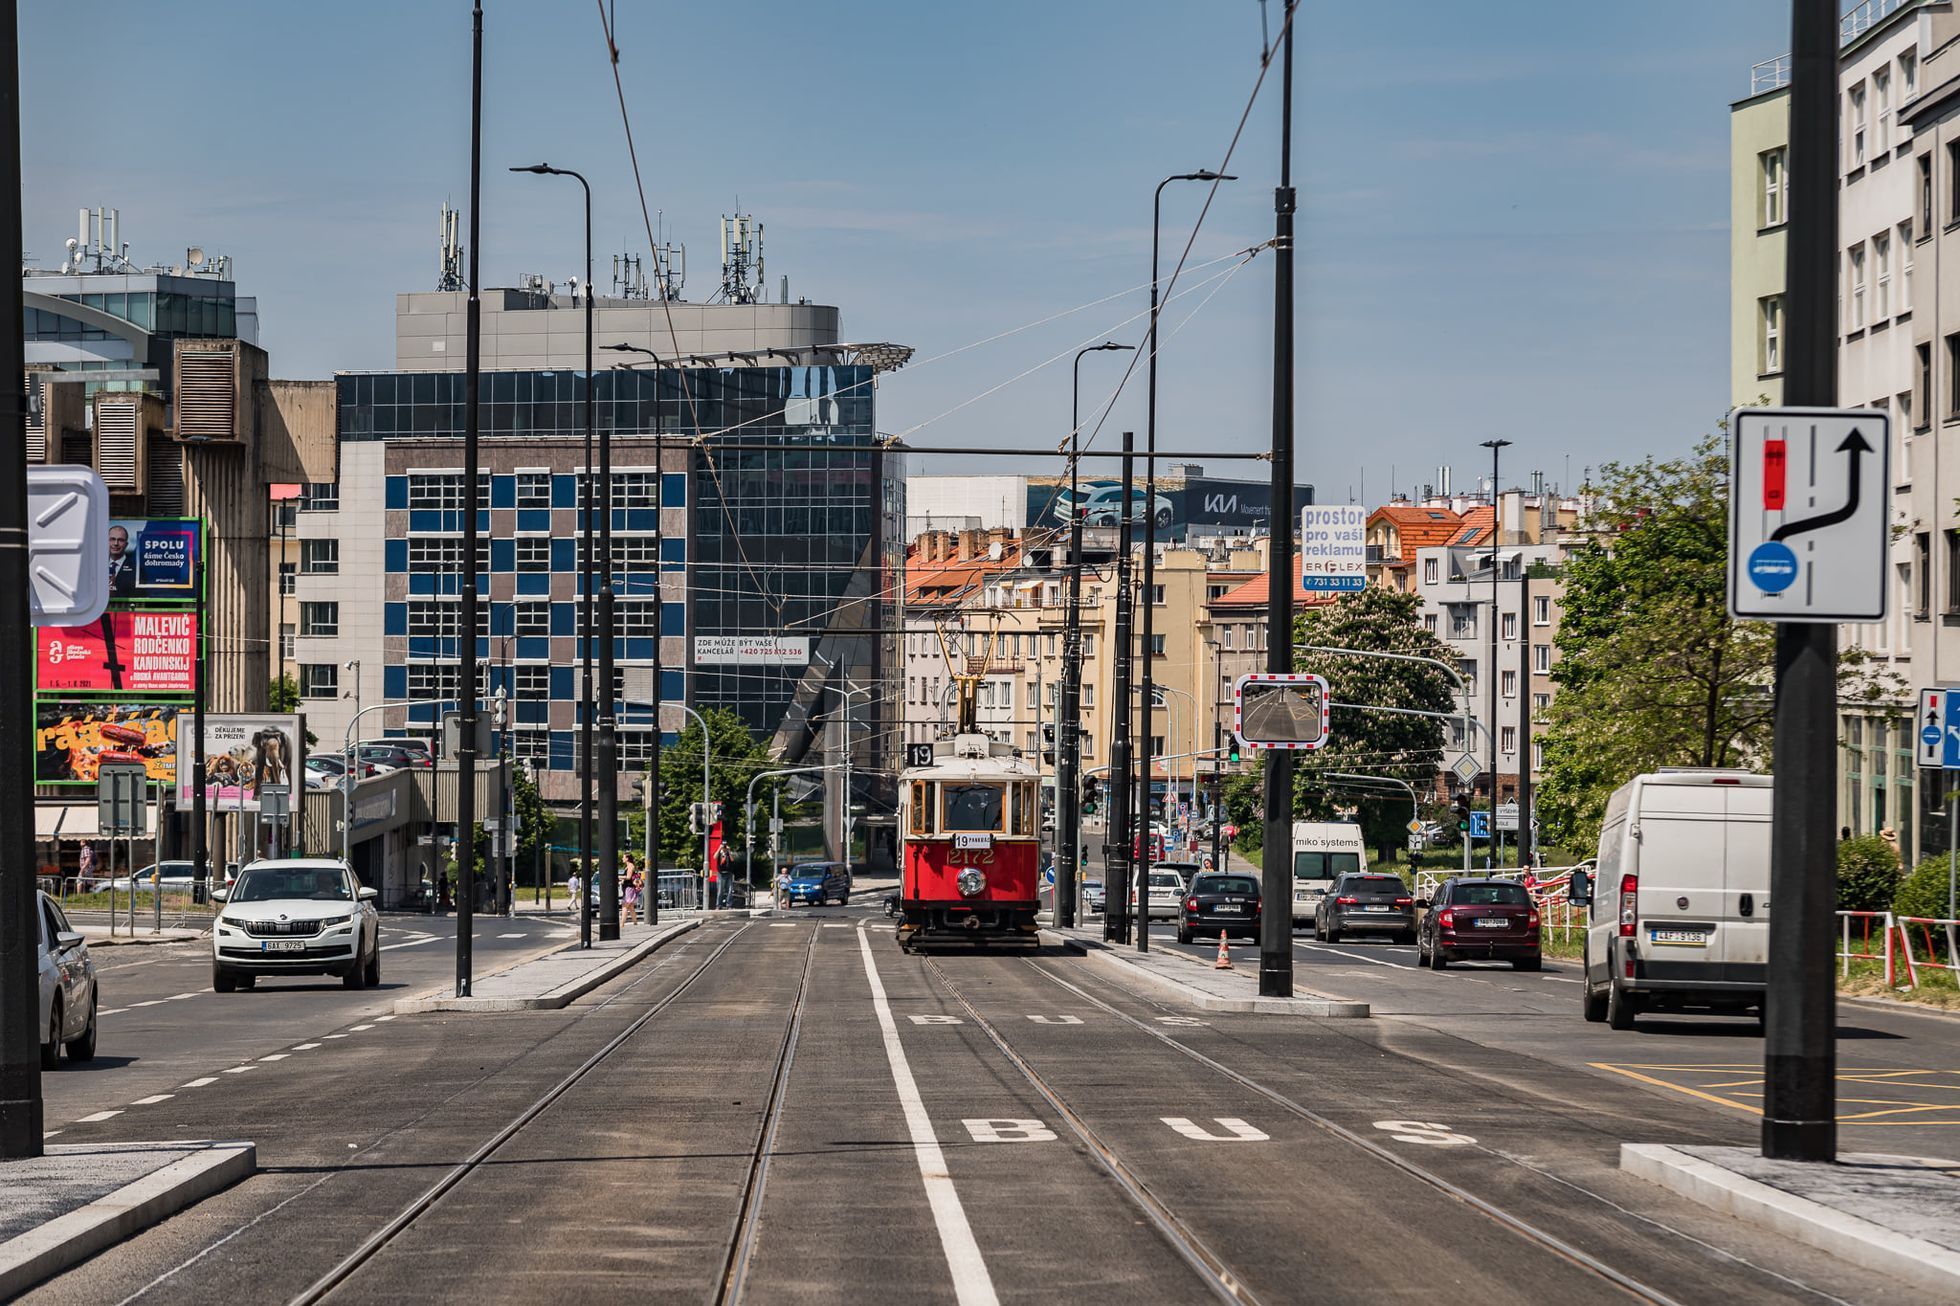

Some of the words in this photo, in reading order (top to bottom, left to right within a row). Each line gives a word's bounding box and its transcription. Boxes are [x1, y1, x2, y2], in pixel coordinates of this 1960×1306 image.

[1204, 493, 1237, 513] KIA
[1306, 507, 1363, 528] prostor
[1306, 531, 1328, 543] pro
[1335, 528, 1363, 541] vaši
[145, 540, 184, 549] SPOLU
[1306, 544, 1363, 556] reklamu
[1314, 578, 1327, 586] 731
[1342, 578, 1350, 586] 11
[134, 614, 190, 636] MALEVIČ
[134, 634, 189, 655] RODČENKO
[714, 638, 736, 646] MŮŽE
[739, 638, 753, 646] BÝT
[755, 638, 772, 646] VAŠE
[697, 647, 734, 655] KANCELÁŘ
[133, 656, 189, 670] KANDINSKIJ
[913, 746, 931, 765] 19
[956, 835, 968, 847] 19
[1296, 838, 1318, 846] miko
[1320, 838, 1359, 848] systems
